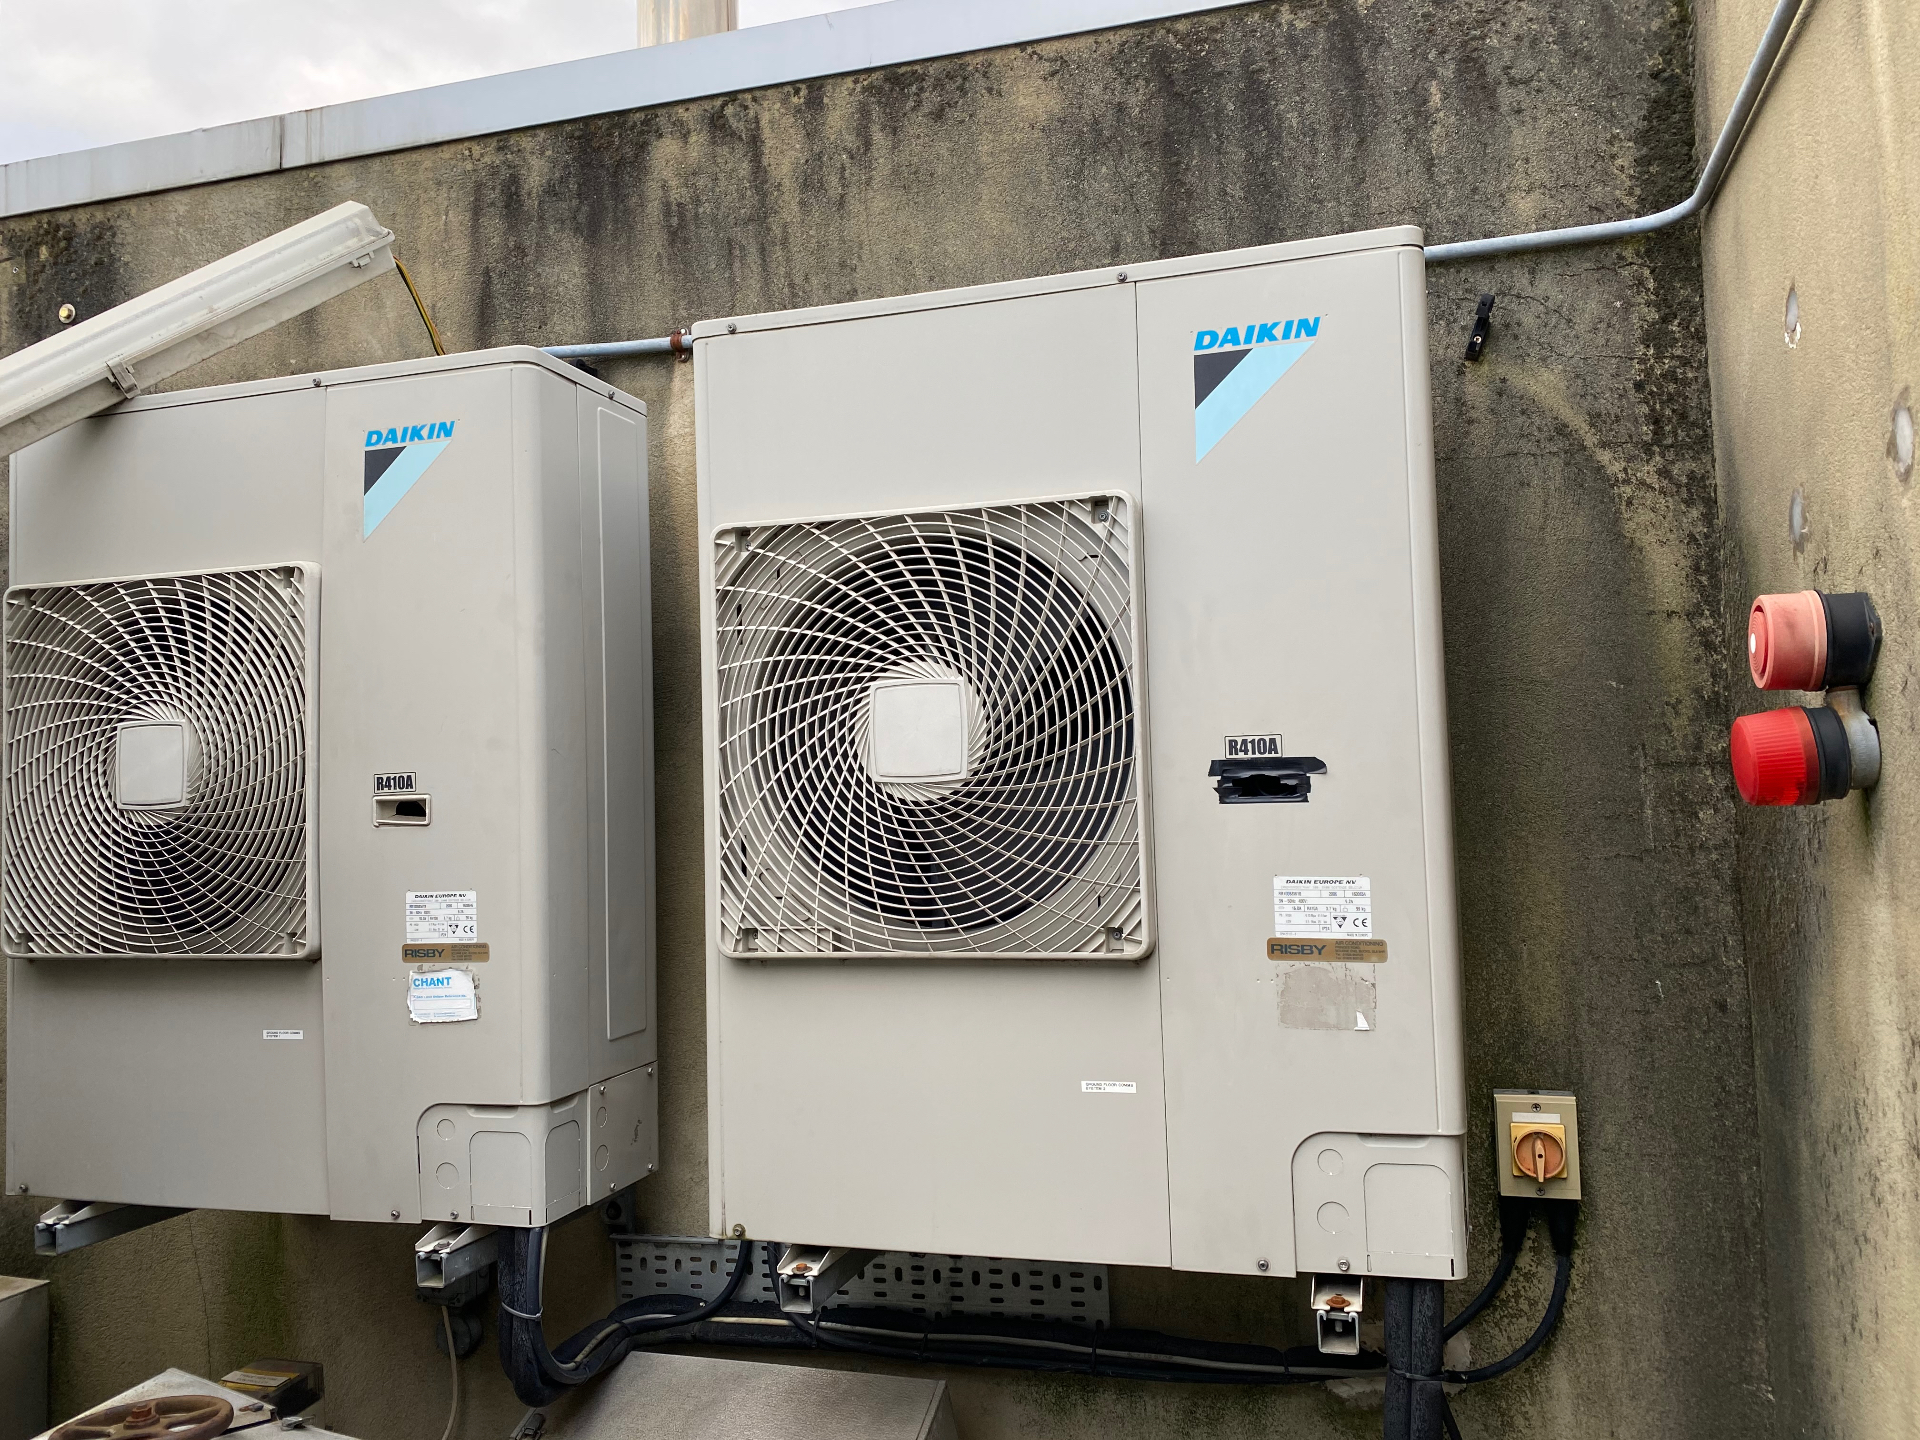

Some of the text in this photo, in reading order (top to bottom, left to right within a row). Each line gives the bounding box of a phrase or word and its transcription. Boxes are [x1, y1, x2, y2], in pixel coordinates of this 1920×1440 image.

[1194, 316, 1321, 351] DAIKIN
[365, 420, 456, 447] DAIKIN
[1228, 737, 1279, 756] R410A
[376, 774, 414, 791] R410A
[404, 948, 446, 958] RISBY
[1270, 944, 1327, 956] RISBY
[413, 976, 452, 987] CHANT
